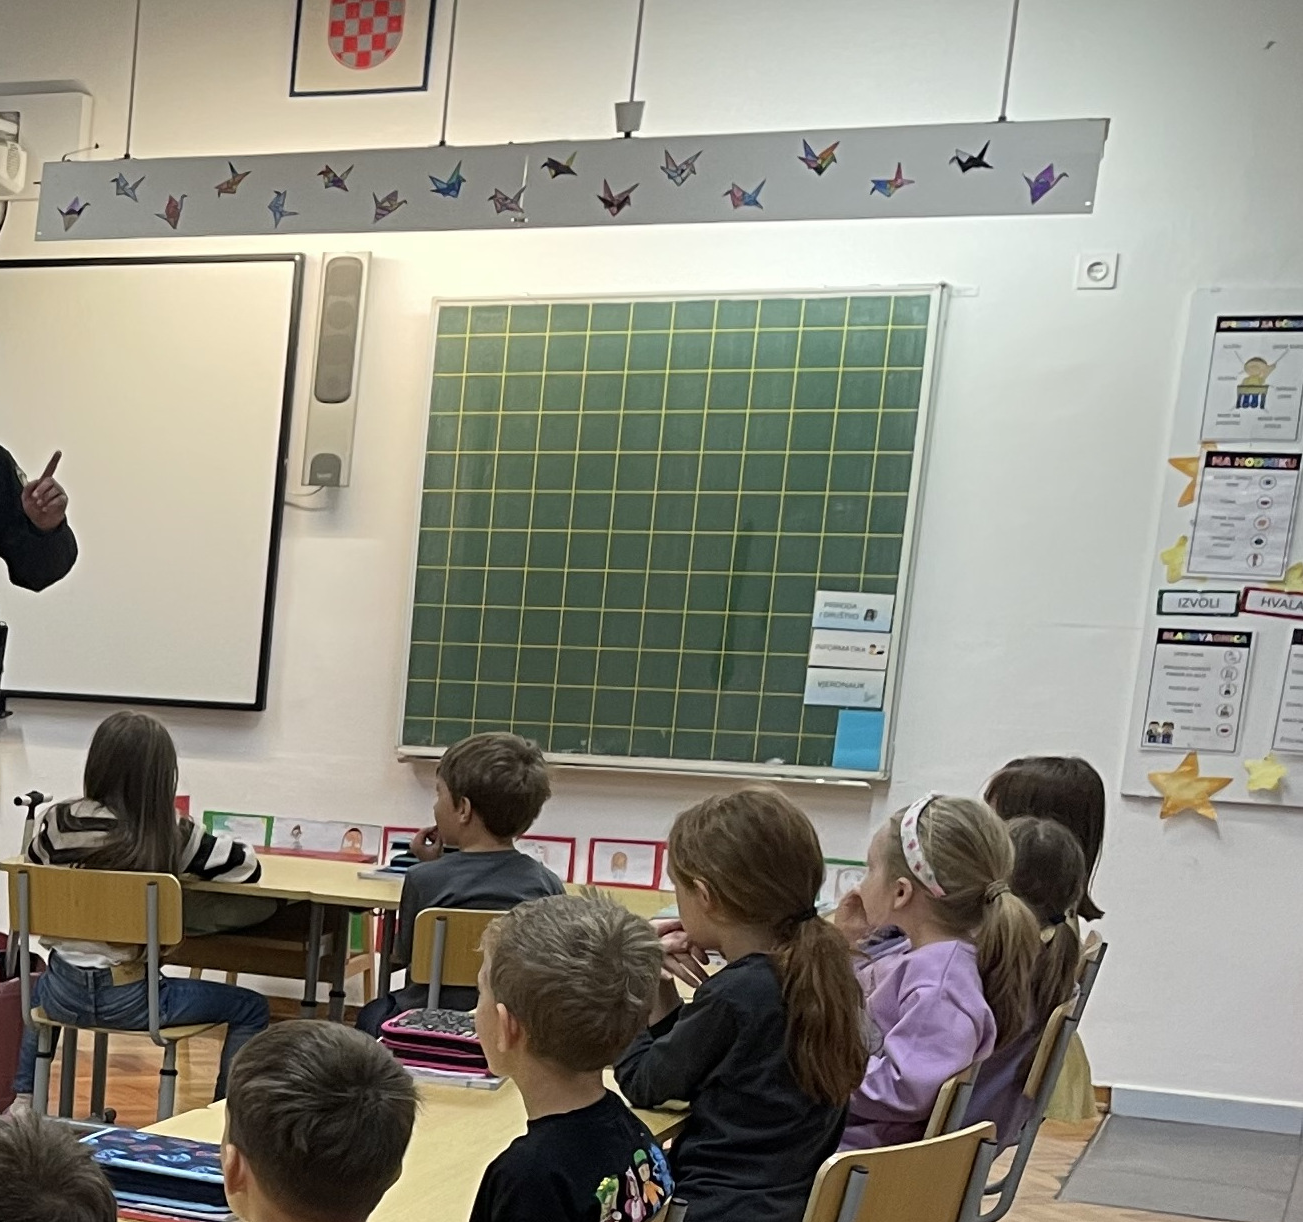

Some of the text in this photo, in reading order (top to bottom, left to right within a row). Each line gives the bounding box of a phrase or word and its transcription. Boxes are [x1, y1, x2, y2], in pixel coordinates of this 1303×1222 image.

[1211, 456, 1297, 468] NA HODNIKU
[1177, 597, 1220, 609] IZVOLI
[1260, 595, 1303, 611] HVALA
